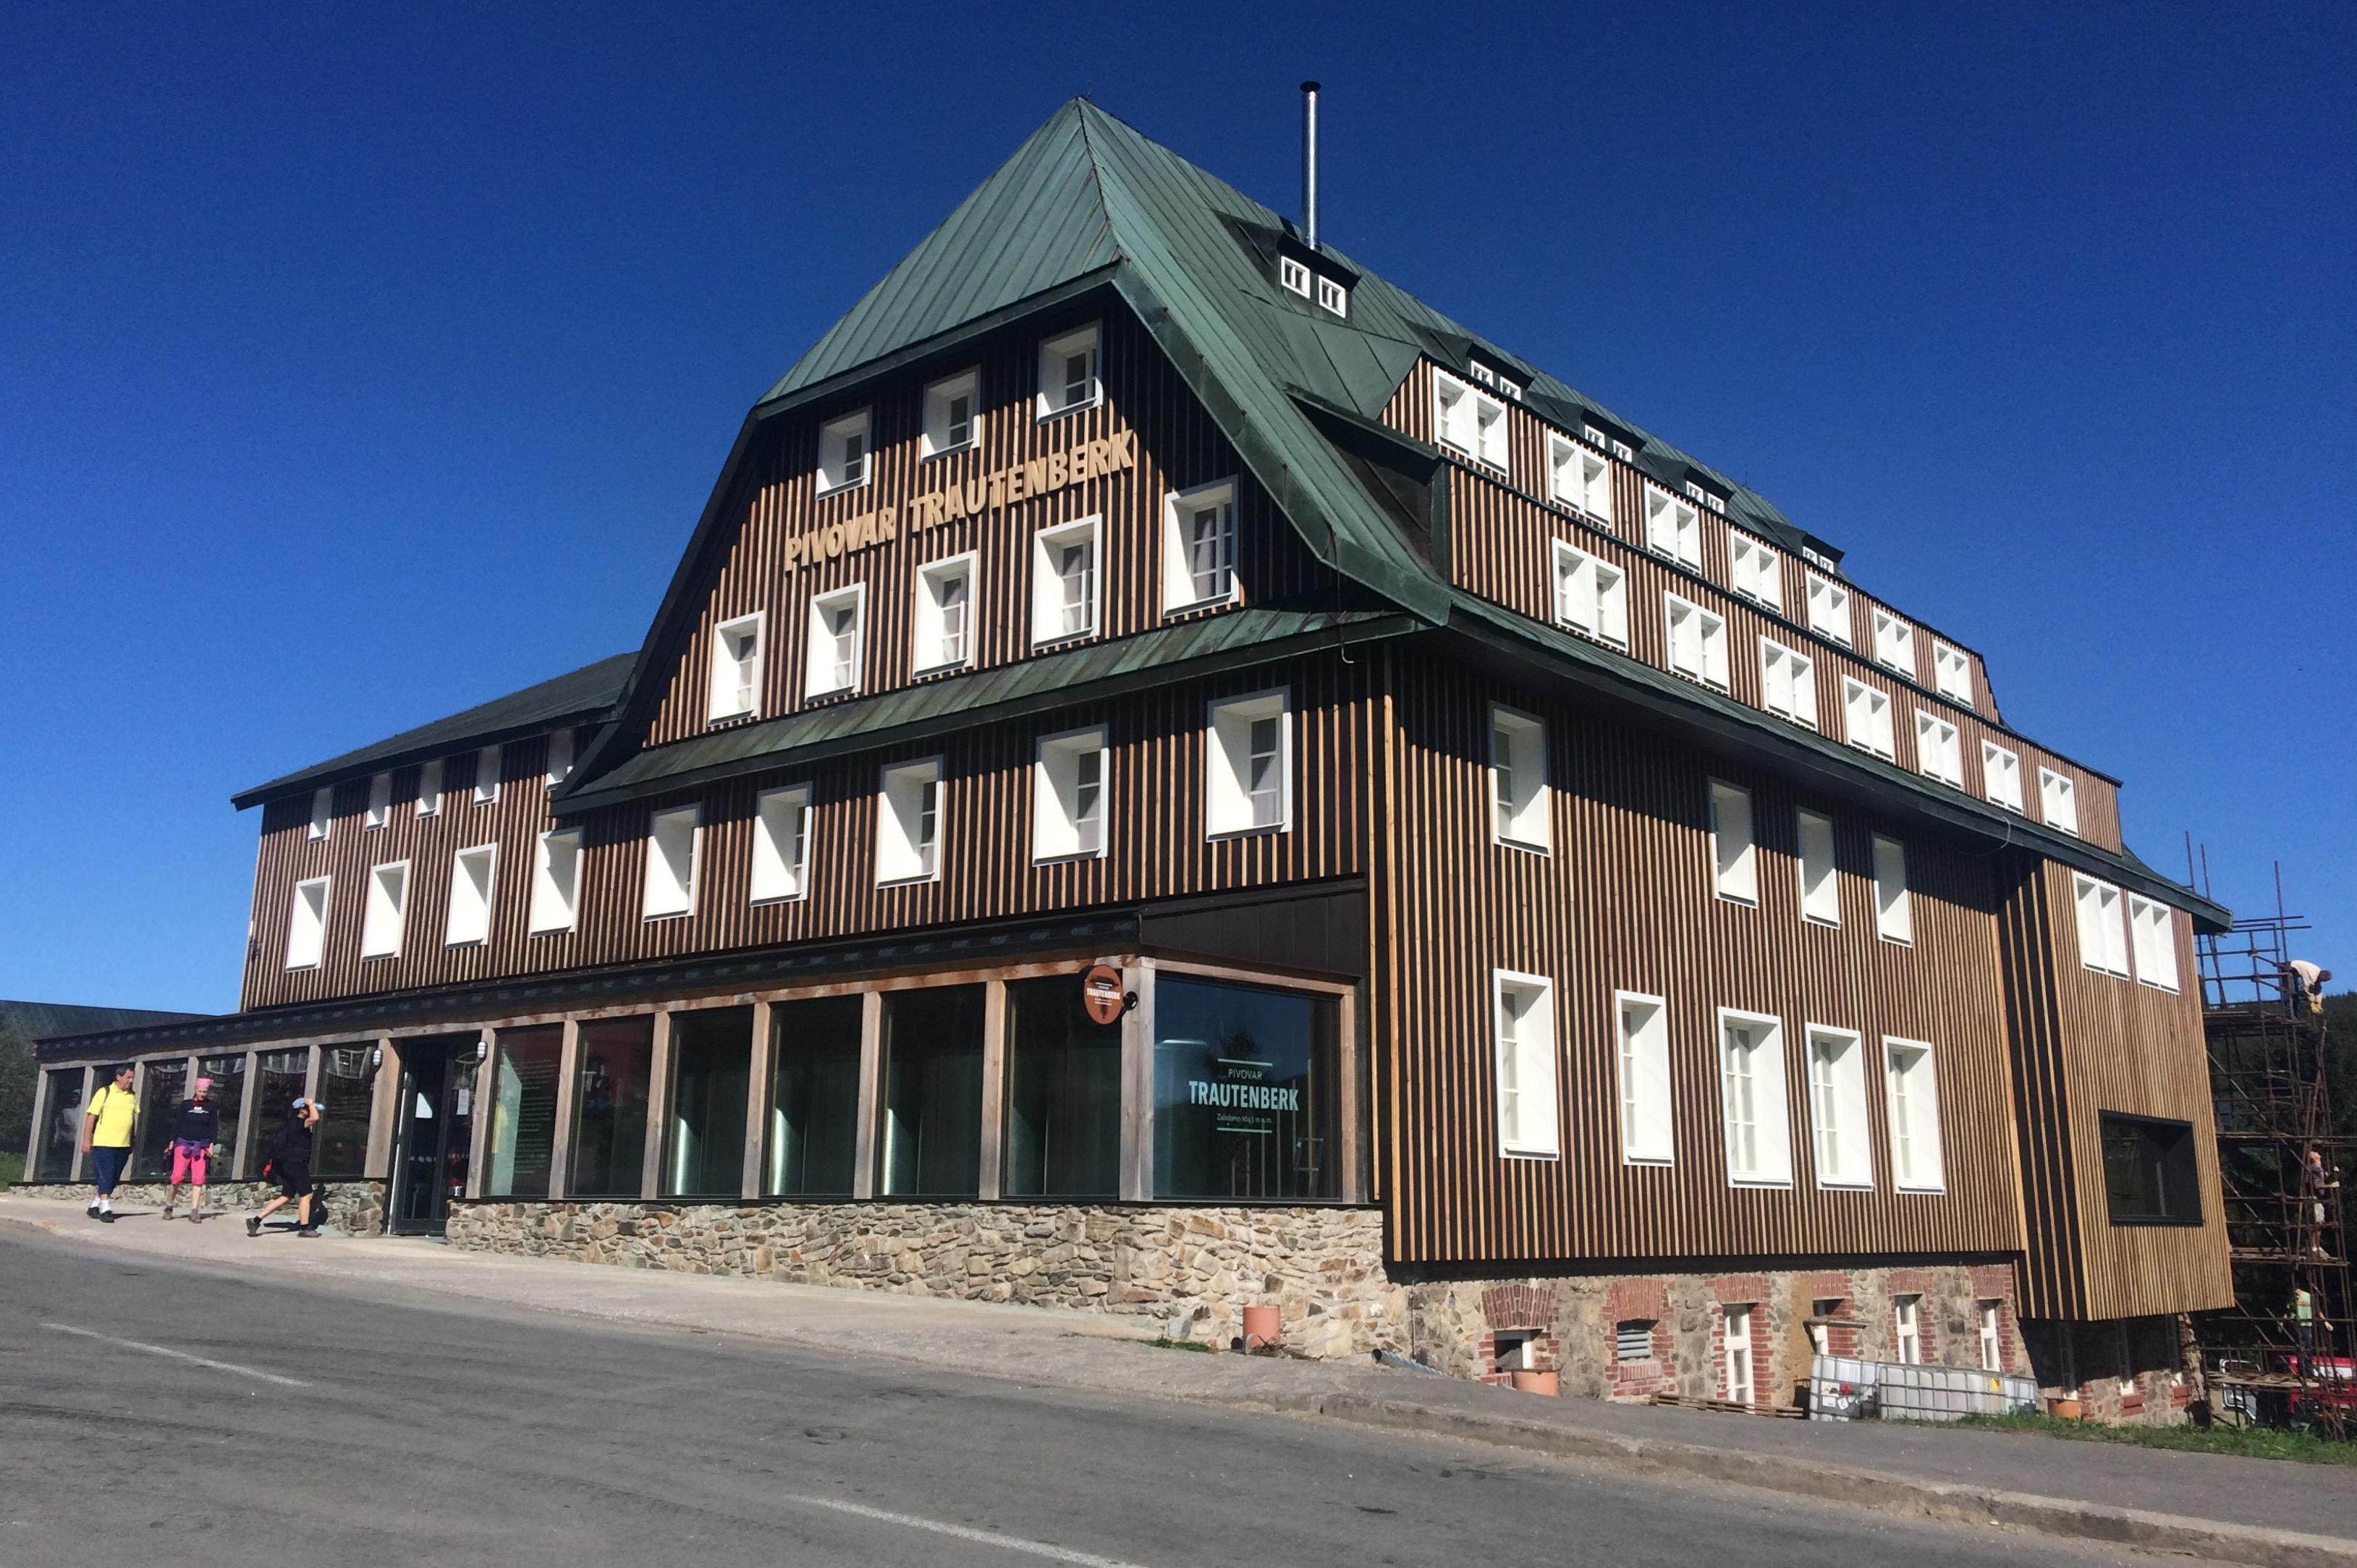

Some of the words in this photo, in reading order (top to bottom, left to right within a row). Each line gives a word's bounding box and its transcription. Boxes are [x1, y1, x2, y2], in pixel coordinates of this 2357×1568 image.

[784, 507, 895, 572] PIVOVAR
[909, 429, 1134, 533] TRAUTENBERK
[1228, 1069, 1262, 1080] PIVOVAR
[1188, 1080, 1299, 1111] TRAUTENBERK
